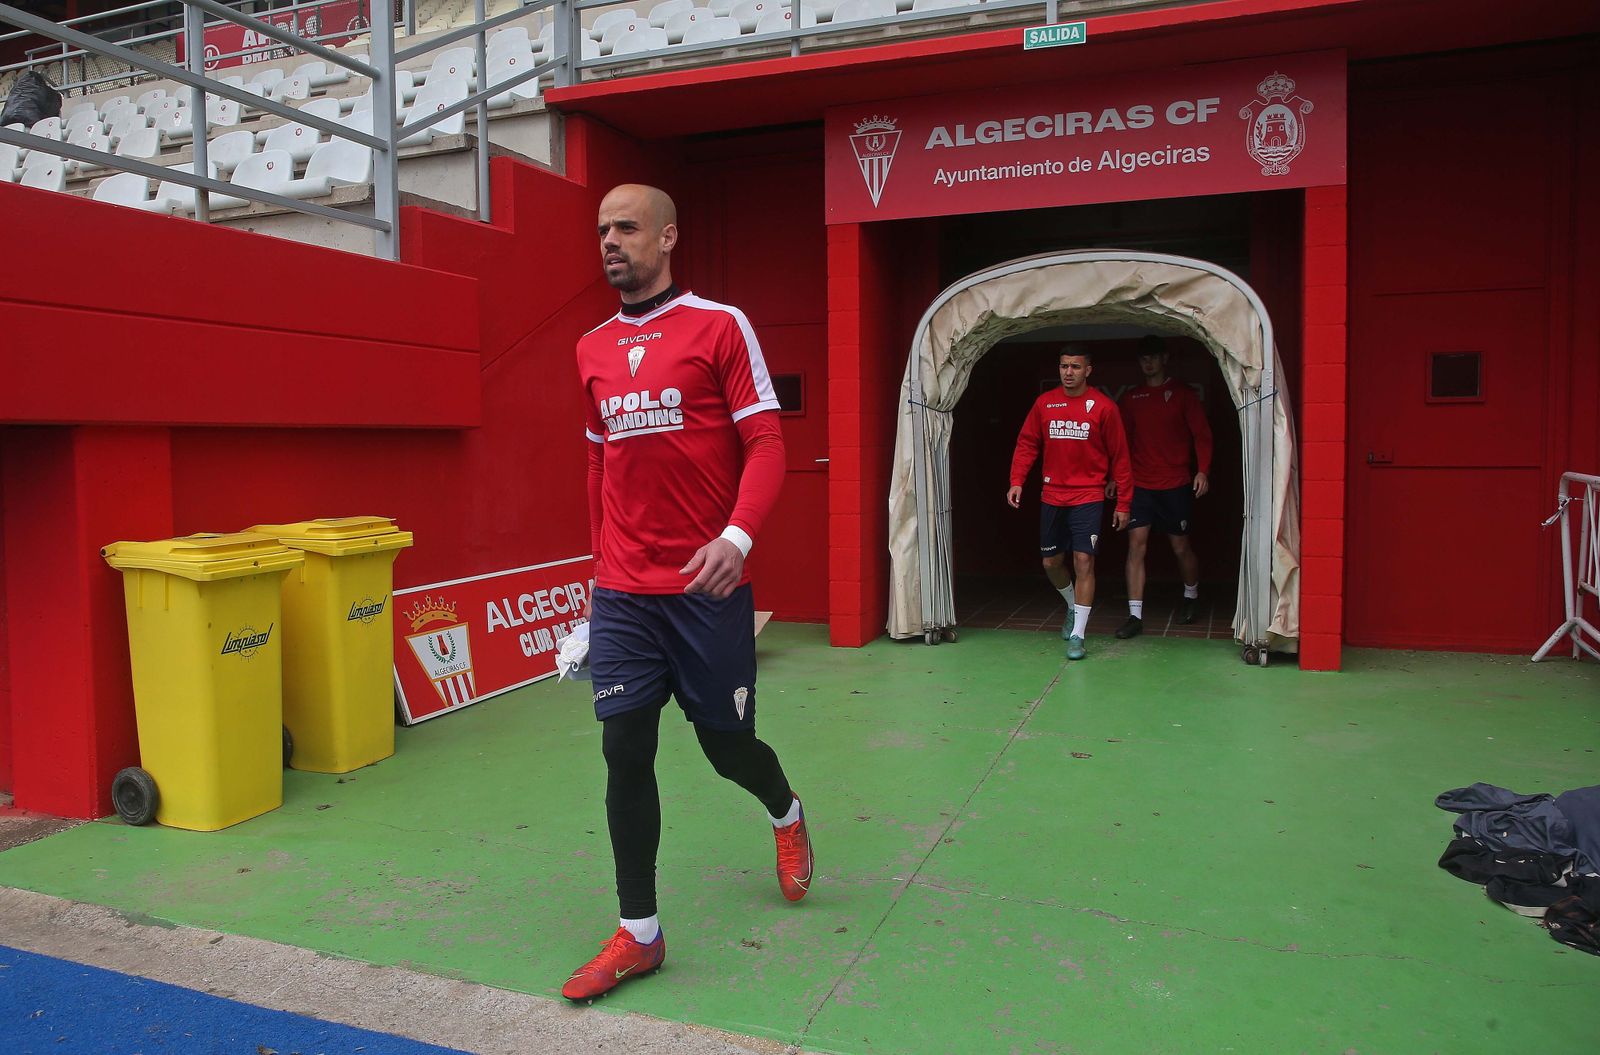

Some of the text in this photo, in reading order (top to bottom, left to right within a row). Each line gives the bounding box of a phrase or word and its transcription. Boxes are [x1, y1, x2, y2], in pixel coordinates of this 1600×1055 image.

[1030, 26, 1080, 44] SALIDA
[925, 97, 1220, 150] ALGECIRAS CF
[933, 145, 1210, 187] Ayuntamiento de Algeciras
[617, 332, 662, 346] GIVOVA
[600, 387, 682, 418] APOLO
[1049, 420, 1090, 431] APOLO
[1049, 428, 1089, 438] BRANDING
[347, 595, 387, 620] Limpiasol
[487, 579, 594, 633] ALGECIR
[221, 623, 273, 654] Limpiasol
[519, 628, 554, 657] CLUB
[552, 622, 570, 642] DE
[434, 664, 460, 677] ALGECIRAS
